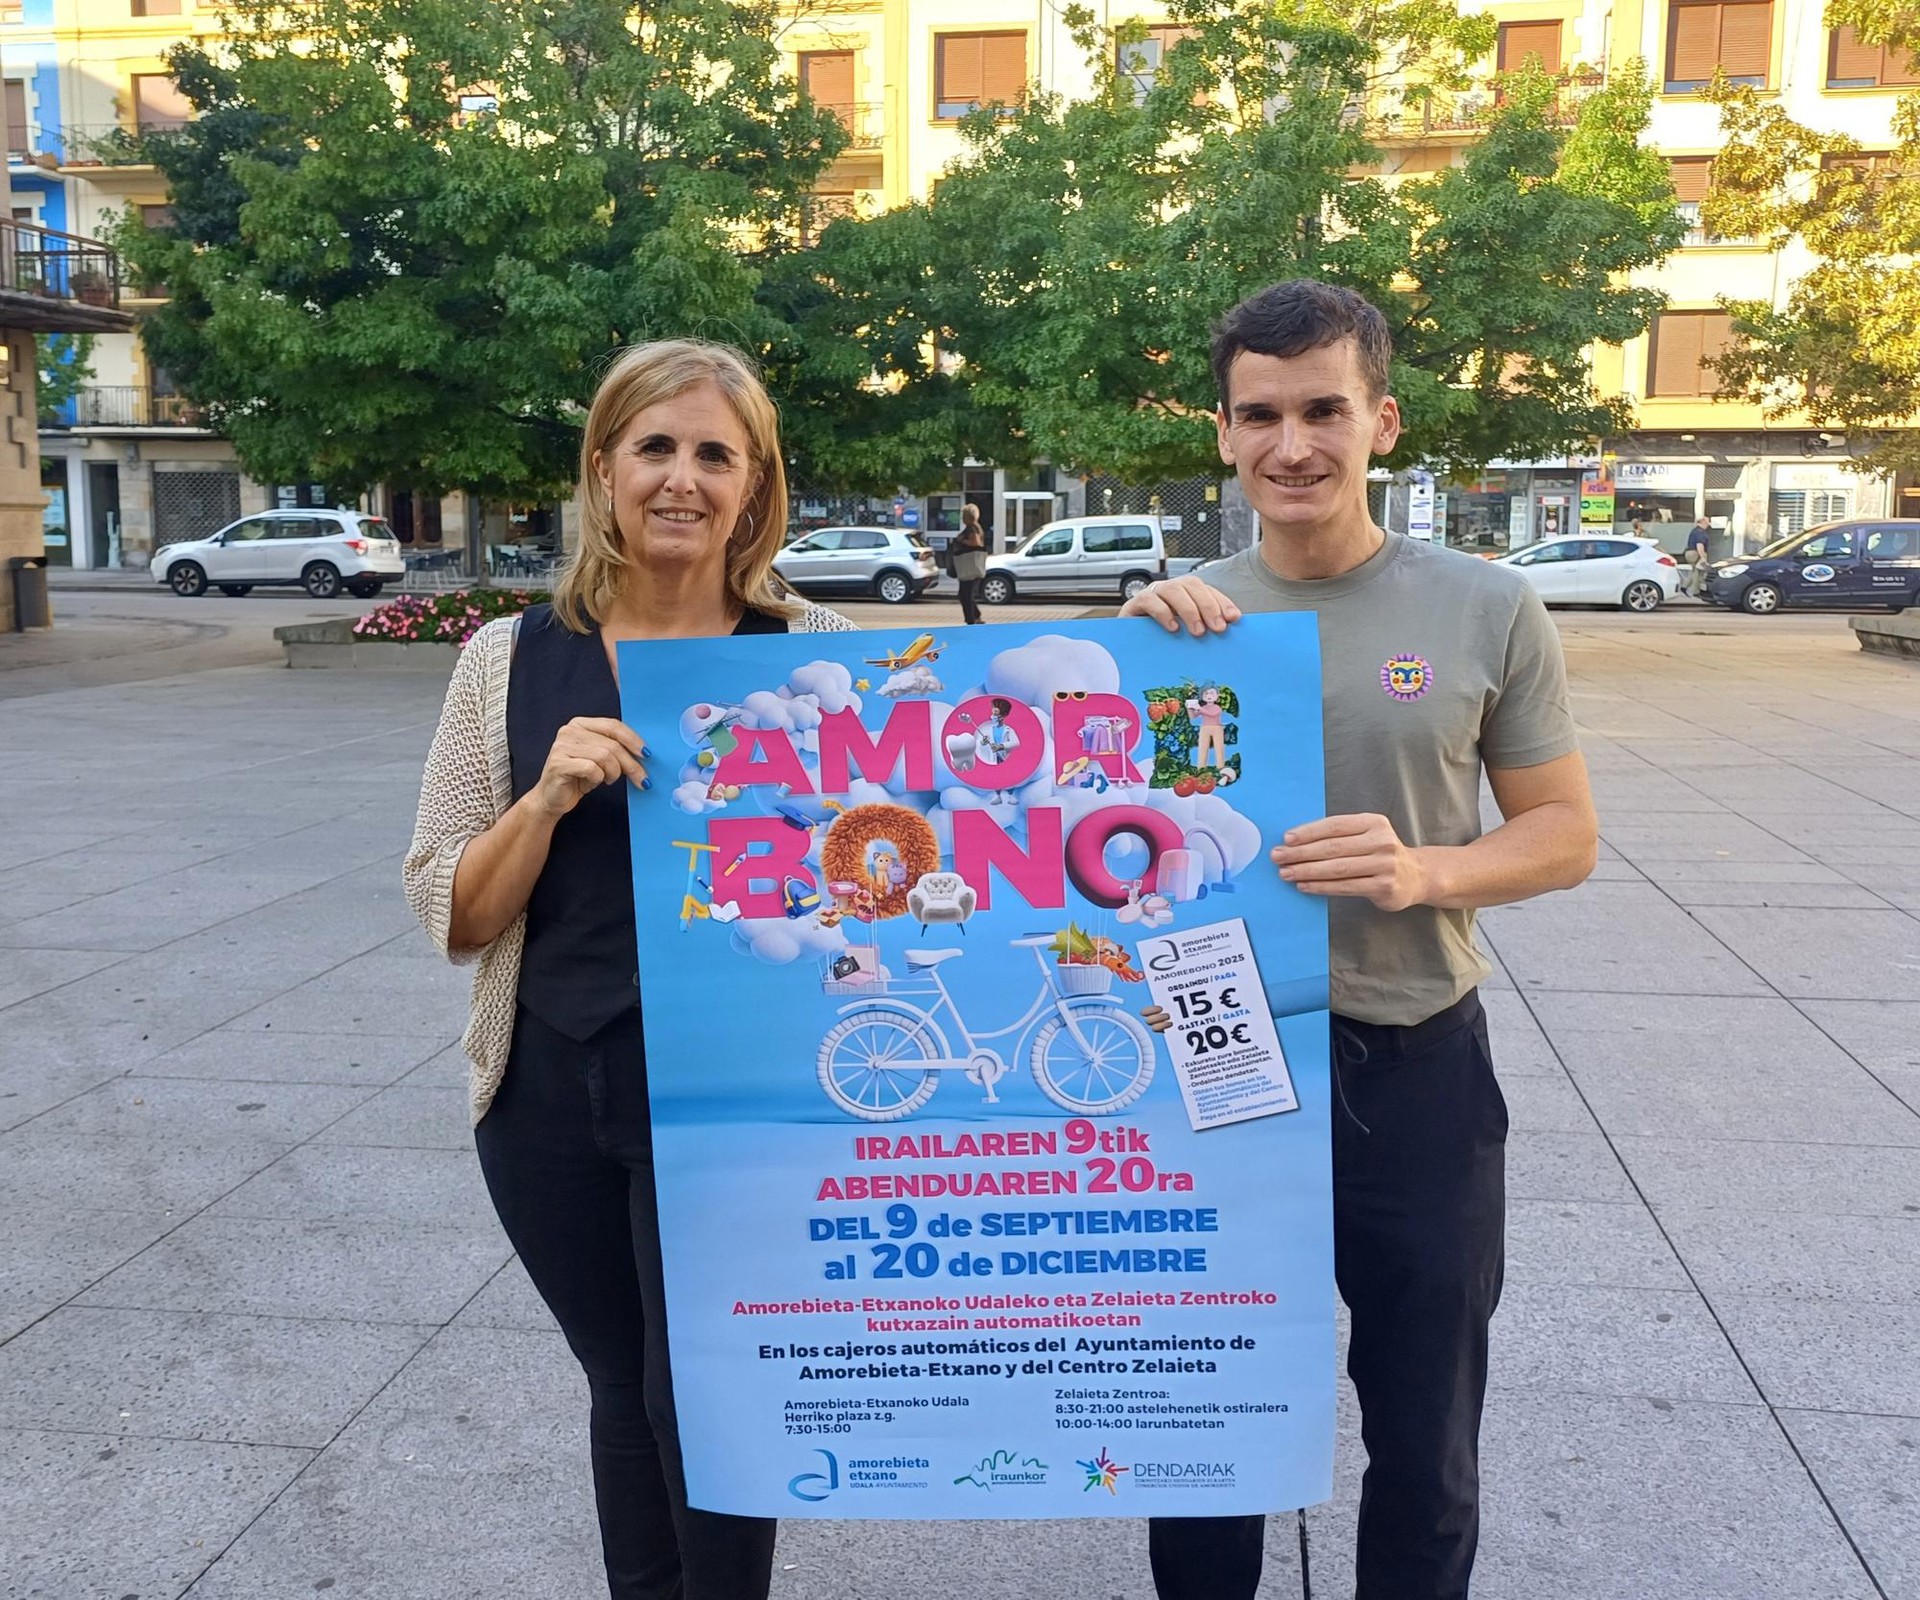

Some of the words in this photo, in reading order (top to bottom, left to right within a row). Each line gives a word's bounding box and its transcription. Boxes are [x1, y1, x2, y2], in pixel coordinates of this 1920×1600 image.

[706, 687, 1242, 796] AMORE
[708, 803, 1187, 919] BONO
[1181, 931, 1230, 948] amorebieta
[1183, 943, 1213, 955] etxano
[1154, 962, 1217, 982] AMOREBONO
[1217, 953, 1245, 967] 2025
[1167, 977, 1209, 993] ORDAINDU
[1214, 972, 1238, 981] PAGA
[1173, 990, 1213, 1019] 15
[1219, 987, 1241, 1009] €
[1178, 1016, 1216, 1031] GASTATU
[1222, 1008, 1251, 1020] GASTA
[1191, 1076, 1223, 1087] Ordaindu
[855, 1131, 1057, 1160] IRAILAREN
[1064, 1119, 1150, 1155] 9tik
[815, 1170, 1077, 1201] ABENDUAREN
[1085, 1156, 1194, 1194] 20ra
[810, 1216, 880, 1241] DEL
[886, 1203, 918, 1239] 9
[928, 1213, 972, 1238] de
[981, 1208, 1219, 1236] SEPTIEMBRE
[824, 1254, 856, 1280] al
[871, 1243, 940, 1278] 20
[948, 1252, 993, 1277] de
[1001, 1248, 1208, 1276] DICIEMBRE
[732, 1296, 960, 1316] Amorebieta-Etxanoko
[965, 1294, 1050, 1311] Udaleko
[1053, 1294, 1087, 1307] eta
[1090, 1290, 1176, 1307] Zelaieta
[1180, 1289, 1278, 1305] Zentroko
[866, 1315, 969, 1332] kutxazain
[974, 1312, 1142, 1329] automatikoetan
[758, 1345, 785, 1359] En
[790, 1343, 819, 1358] los
[823, 1341, 897, 1360] cajeros
[901, 1338, 1030, 1356] automáticos
[1034, 1337, 1066, 1353] del
[1075, 1335, 1226, 1355] Ayuntamiento
[1229, 1335, 1256, 1350] de
[799, 1362, 1001, 1380] Amorebieta-Etxano
[1005, 1363, 1018, 1378] y
[1021, 1359, 1053, 1374] del
[1058, 1359, 1128, 1374] Centro
[1131, 1357, 1217, 1374] Zelaieta
[784, 1397, 929, 1410] Amorebieta-Etxanoko
[931, 1396, 970, 1407] Udala
[1054, 1389, 1109, 1399] Zelaieta
[1112, 1389, 1170, 1399] Zentroa:
[785, 1412, 833, 1422] Herriko
[837, 1411, 871, 1423] plaza
[874, 1412, 896, 1423] z.g.
[1055, 1403, 1124, 1414] 8:30-21:00
[1127, 1402, 1221, 1414] astelehenetik
[1223, 1402, 1289, 1413] ostiralera
[785, 1424, 851, 1434] 7:30-15:00
[1055, 1418, 1133, 1429] 10:00-14:00
[1135, 1418, 1225, 1429] larunbatetan
[848, 1456, 930, 1469] amorebieta
[1134, 1463, 1235, 1477] DENDARIAK
[849, 1470, 897, 1482] etxano
[991, 1471, 1046, 1481] iraunkor
